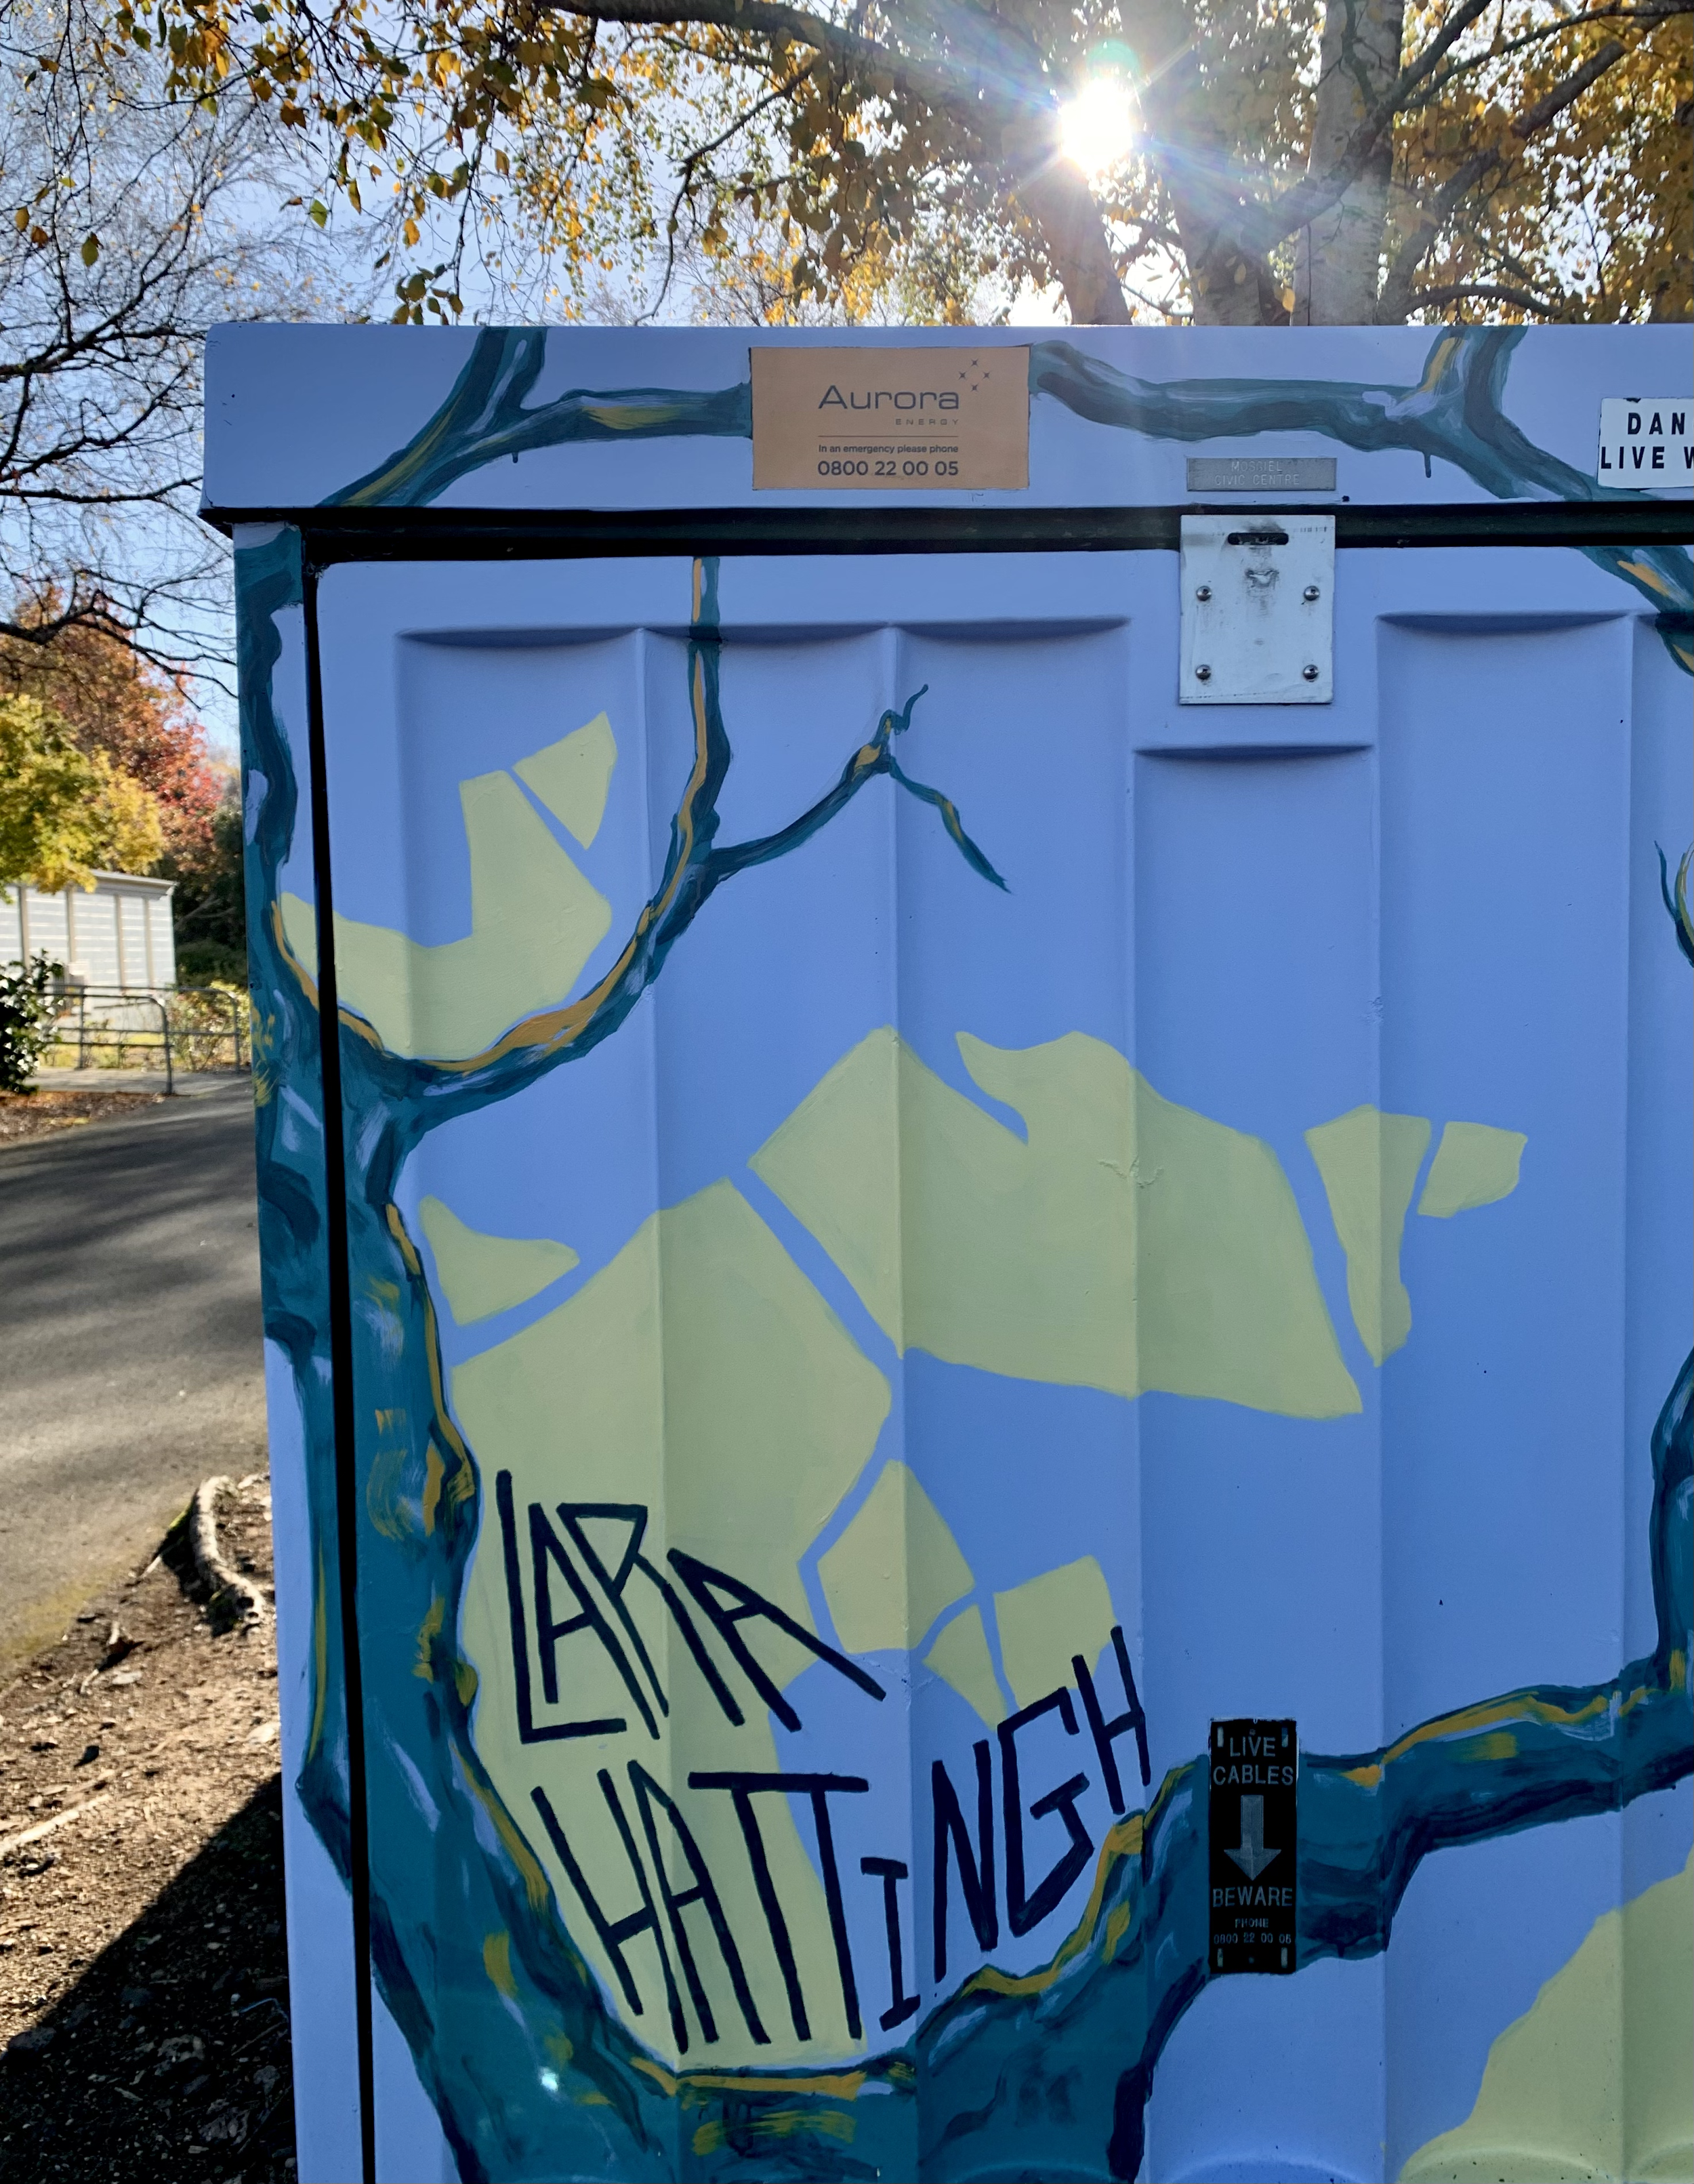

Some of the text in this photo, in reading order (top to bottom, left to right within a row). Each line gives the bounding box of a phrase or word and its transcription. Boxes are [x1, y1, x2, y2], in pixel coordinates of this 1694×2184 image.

[818, 384, 959, 410] Aurora
[1628, 412, 1685, 435] DAN
[819, 445, 827, 453] In
[843, 446, 895, 455] emergency
[897, 444, 927, 454] please
[930, 444, 959, 454] phone
[1600, 446, 1665, 469] LIVE
[817, 461, 959, 476] 0800 22 00 05
[1231, 461, 1283, 472] MOSGIEL
[1214, 474, 1300, 486] CIVIC CENTRE
[496, 1468, 886, 1745] LARA
[1229, 1736, 1276, 1757] LIVE
[1213, 1764, 1294, 1786] CABLES
[529, 1625, 1152, 2055] HATTINGH
[1212, 1885, 1293, 1908] BEWARE
[1235, 1918, 1269, 1929] PHONE
[1214, 1933, 1239, 1945] 0800
[1243, 1932, 1255, 1943] 22
[1260, 1932, 1273, 1944] 00
